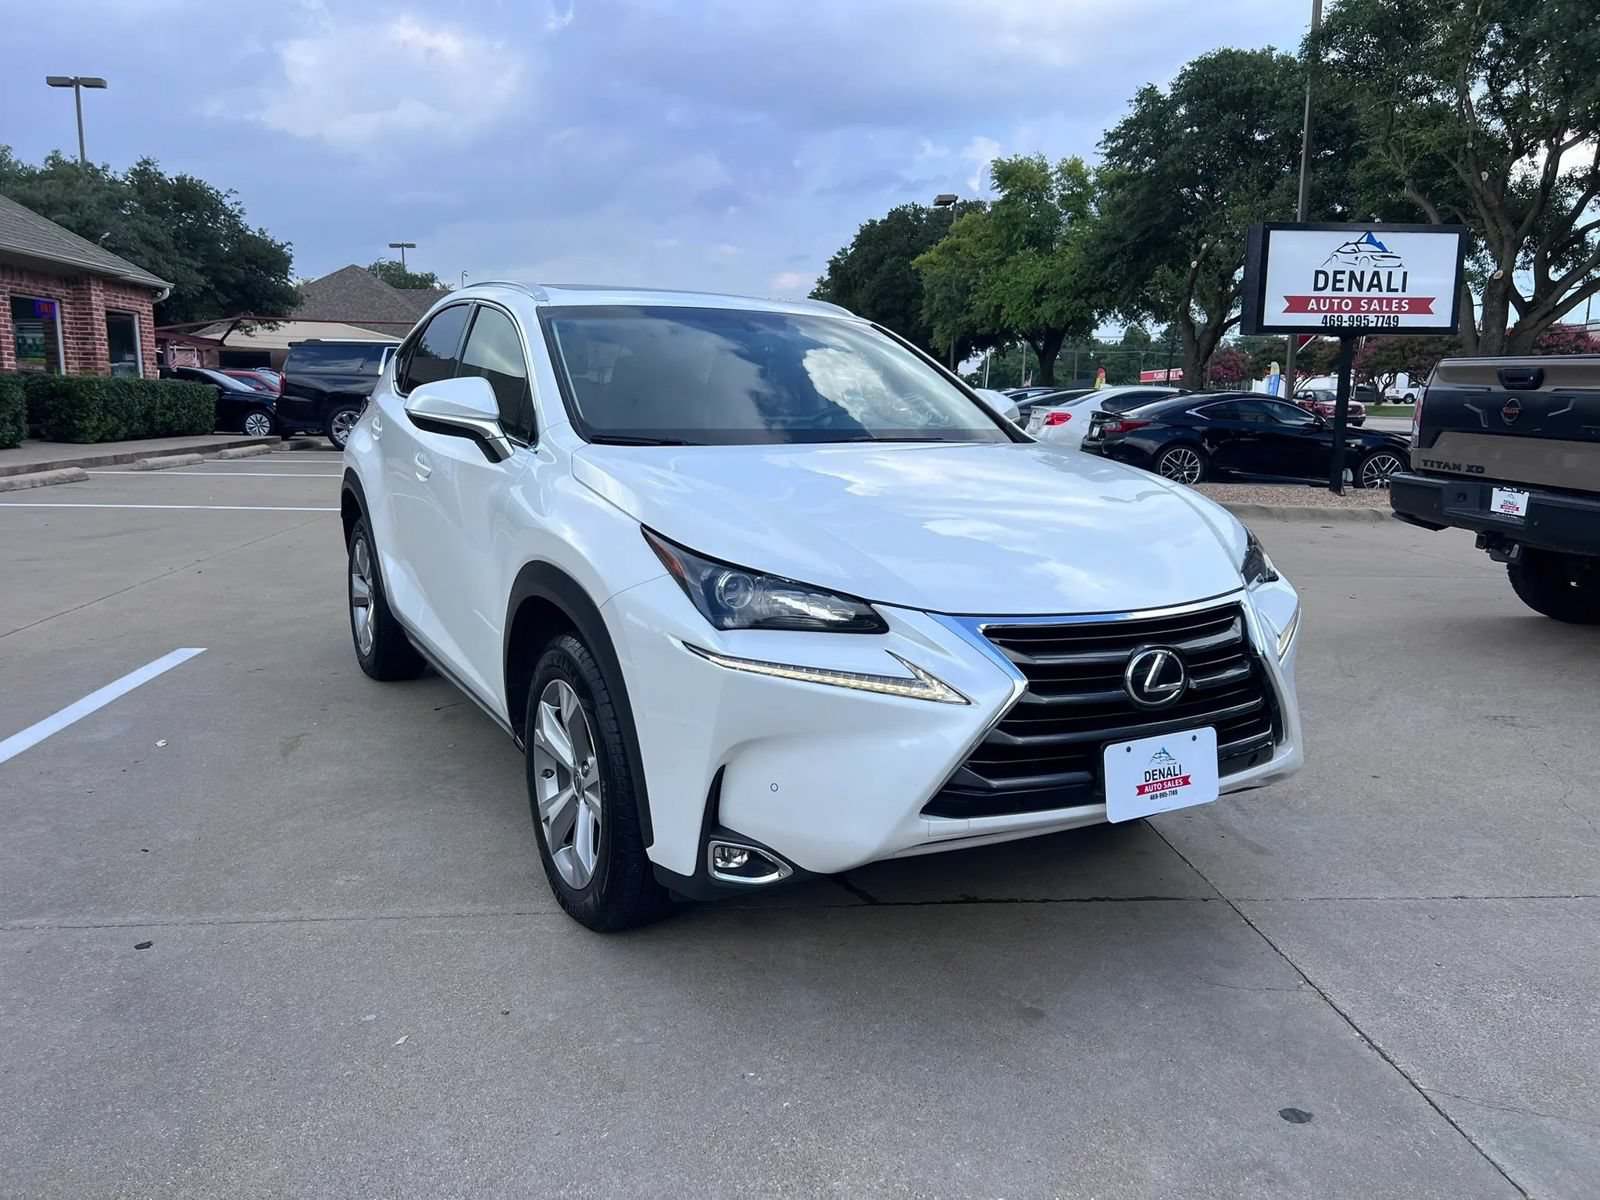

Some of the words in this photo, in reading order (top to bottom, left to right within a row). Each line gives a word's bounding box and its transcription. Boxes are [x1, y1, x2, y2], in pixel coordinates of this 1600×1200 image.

[1313, 269, 1408, 293] DENALI
[1307, 298, 1353, 311] AUTO
[1360, 299, 1409, 312] SALES
[1321, 314, 1399, 327] 469-995-7749
[1421, 459, 1462, 471] TITAN
[1465, 464, 1485, 474] XD
[1144, 764, 1182, 783] DENALI
[1144, 783, 1162, 793] AUTO
[1163, 778, 1184, 789] SALES
